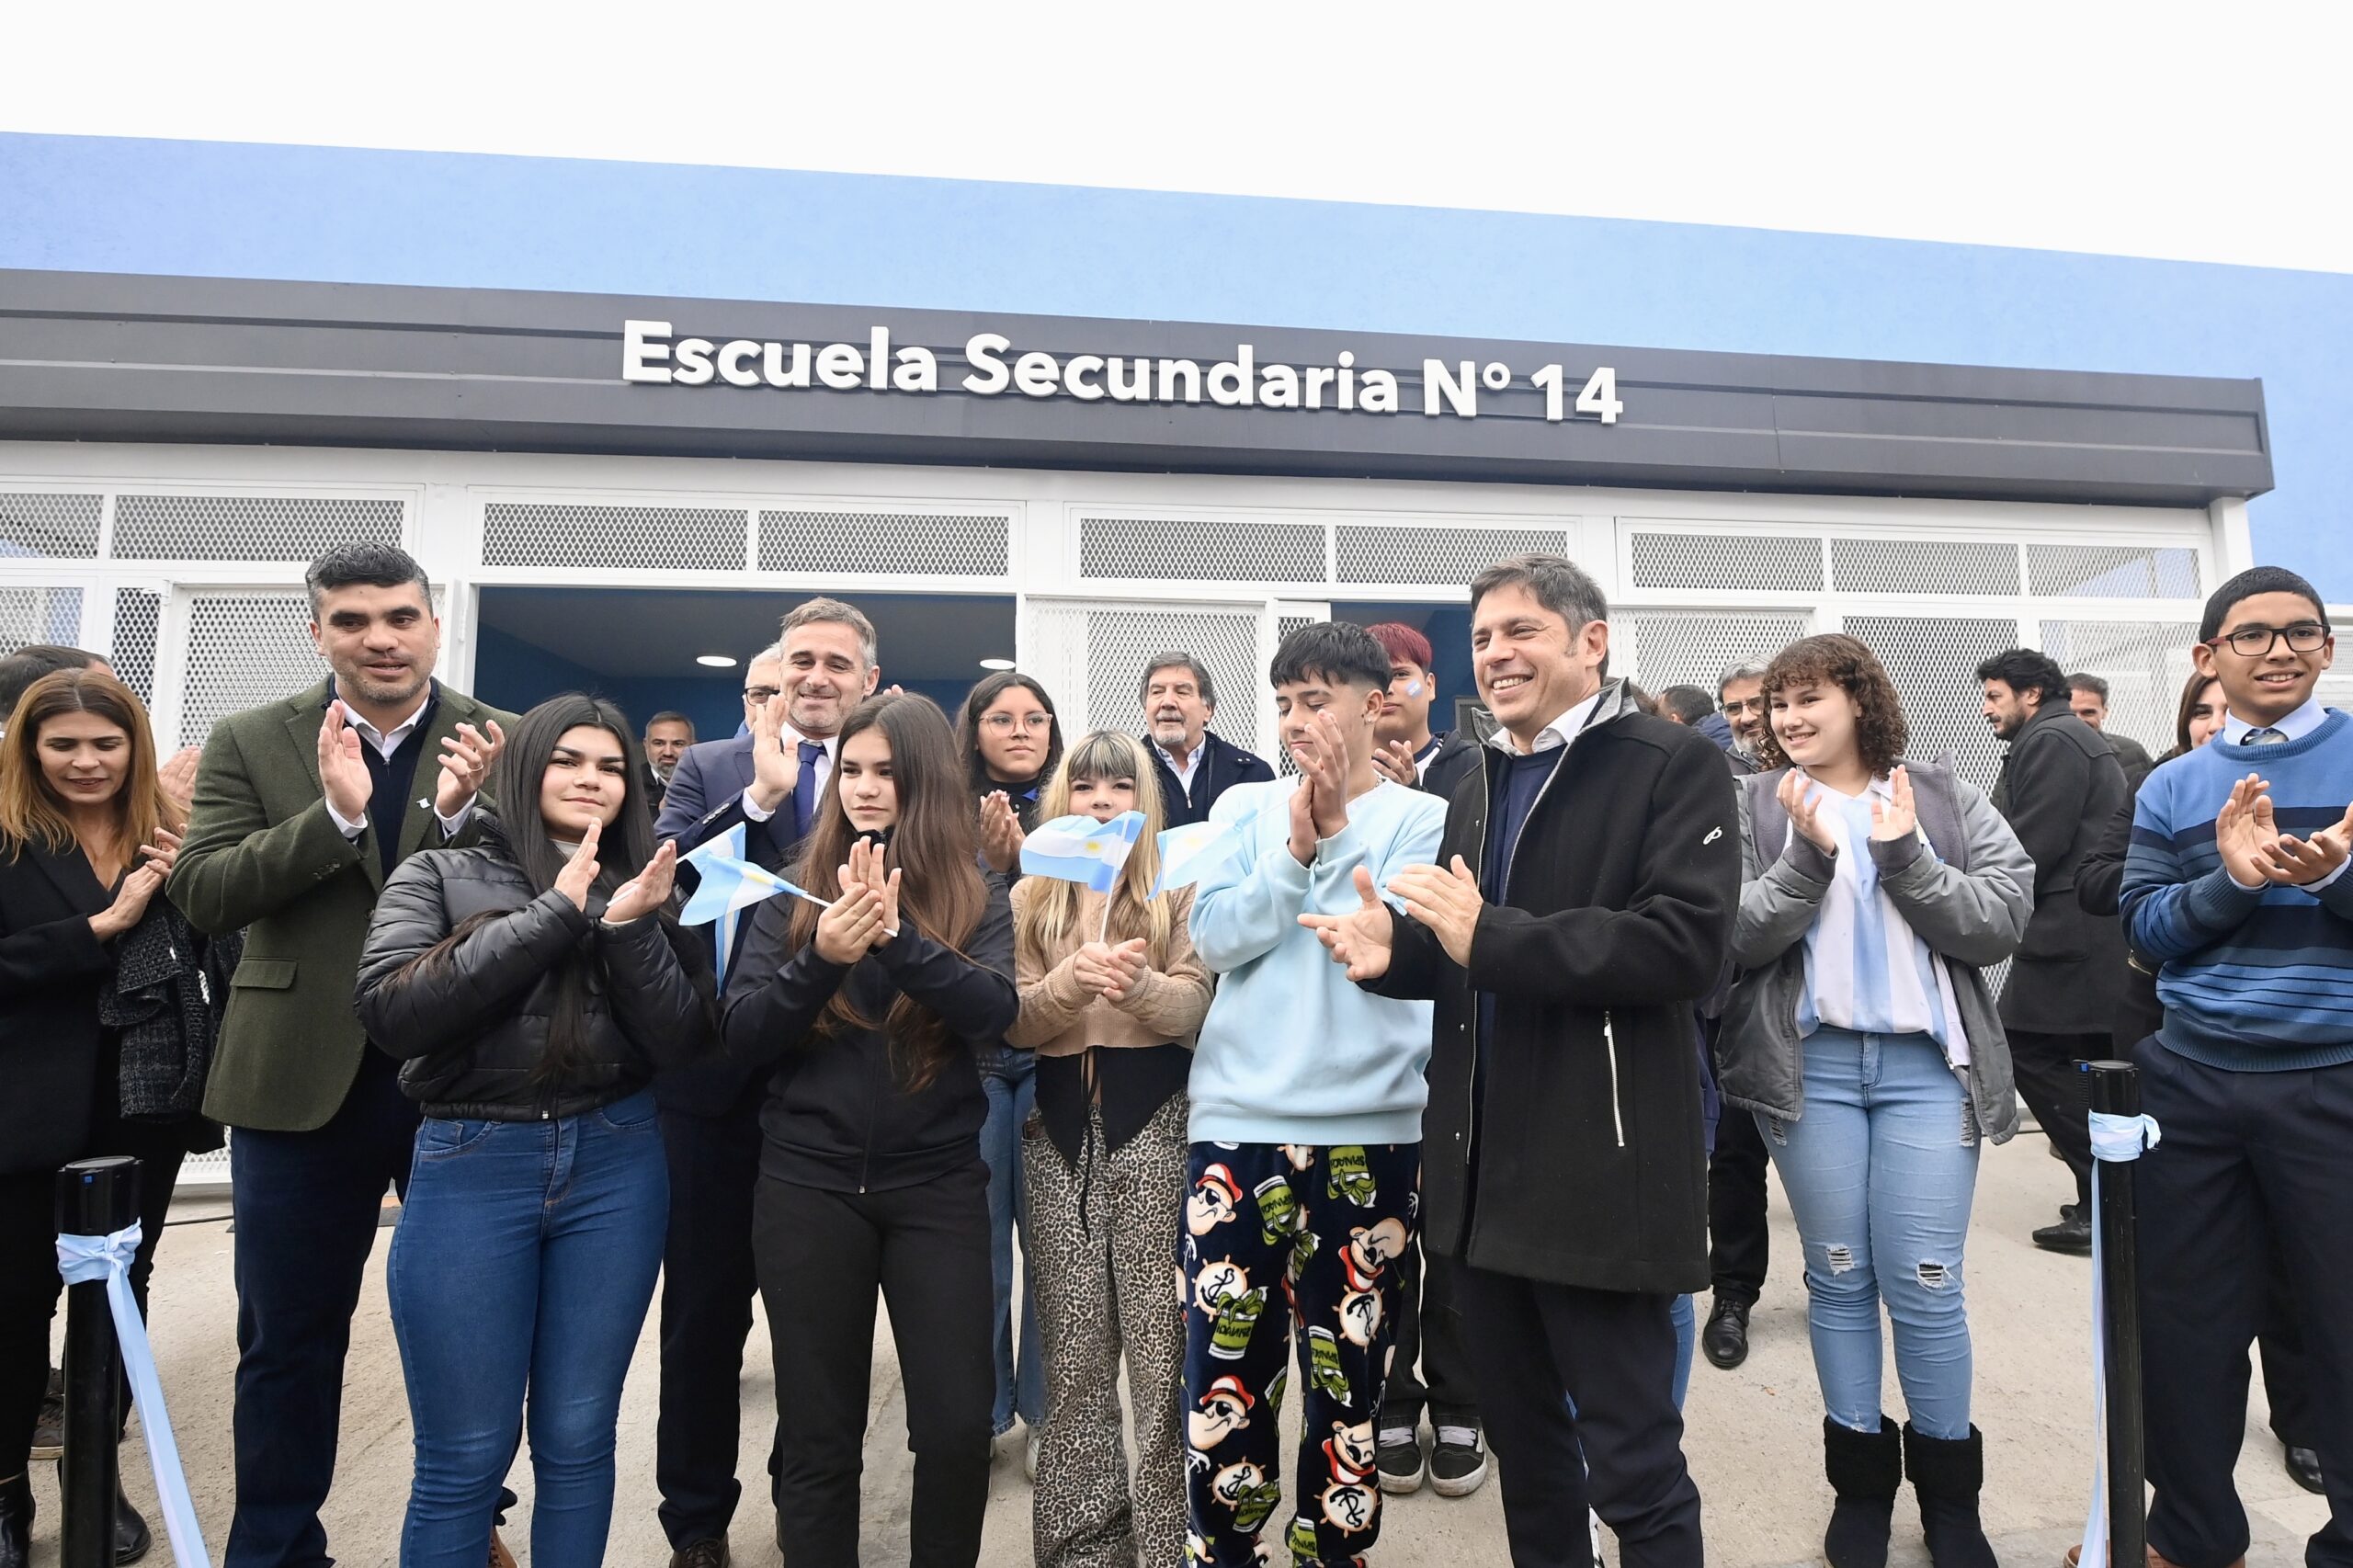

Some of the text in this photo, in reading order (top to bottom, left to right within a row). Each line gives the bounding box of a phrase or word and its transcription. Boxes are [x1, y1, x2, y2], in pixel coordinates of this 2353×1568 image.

[622, 320, 938, 392] Escuela
[961, 333, 1399, 414] Secundaria
[1530, 364, 1624, 424] 14
